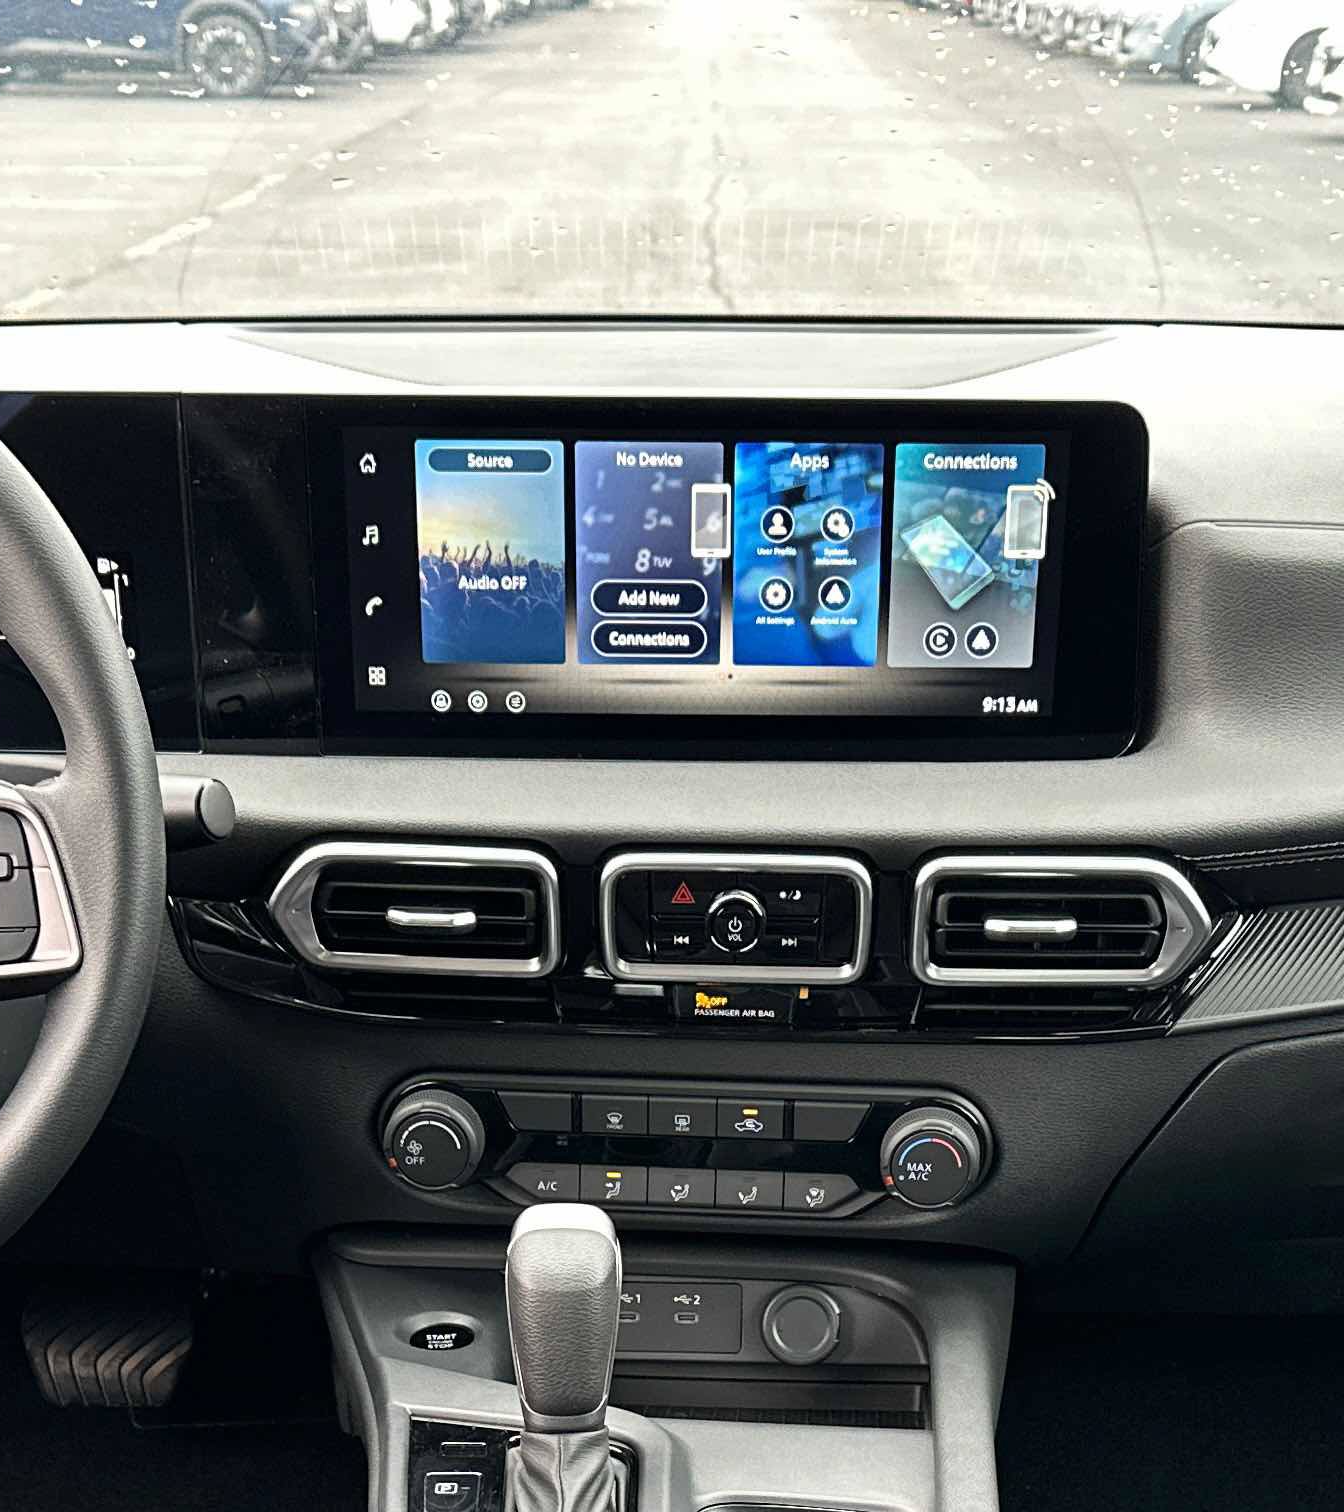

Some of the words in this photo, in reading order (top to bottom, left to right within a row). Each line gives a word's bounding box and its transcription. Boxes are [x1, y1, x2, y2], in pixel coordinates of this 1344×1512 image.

[467, 453, 513, 469] Source
[616, 452, 635, 467] No
[638, 451, 683, 467] Device
[790, 453, 830, 471] Apps
[923, 453, 1018, 470] Connections
[635, 548, 651, 573] 8
[458, 575, 498, 591] Audio
[501, 575, 528, 591] OFF
[618, 590, 647, 606] Add
[649, 591, 680, 607] New
[609, 631, 690, 647] Connections
[982, 696, 1016, 713] 9:13
[1016, 699, 1038, 713] AM
[727, 934, 743, 942] VOL
[694, 1008, 740, 1017] PASSENGER
[742, 1009, 756, 1017] AIR
[758, 1010, 775, 1018] BAG
[405, 1156, 425, 1165] OFF
[906, 1162, 932, 1173] MAX
[907, 1171, 929, 1181] A/C
[537, 1182, 558, 1191] A/C
[635, 1293, 641, 1304] 1
[693, 1294, 701, 1305] 2
